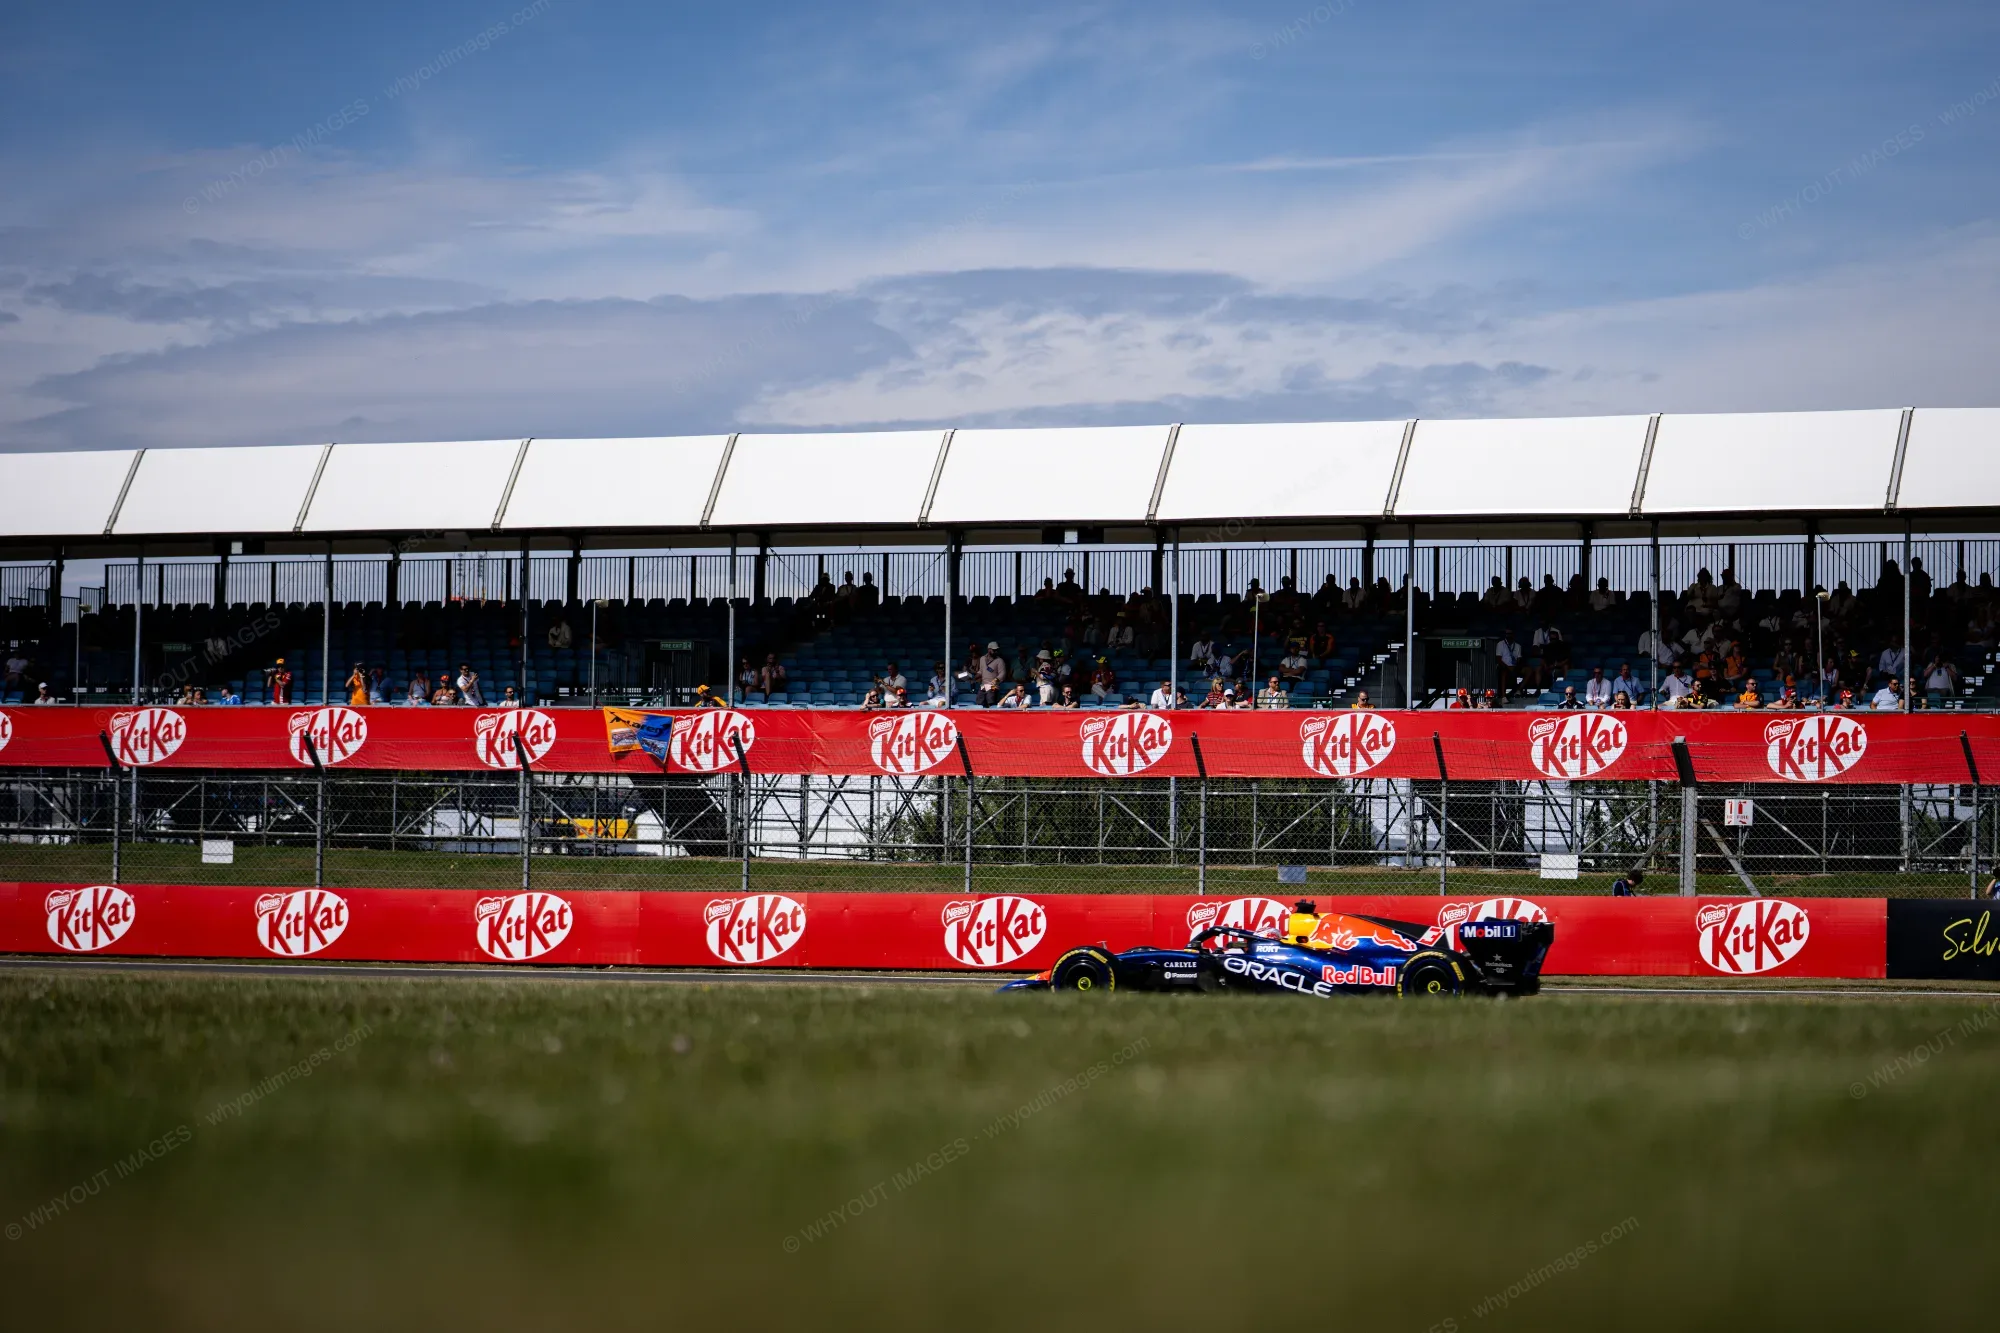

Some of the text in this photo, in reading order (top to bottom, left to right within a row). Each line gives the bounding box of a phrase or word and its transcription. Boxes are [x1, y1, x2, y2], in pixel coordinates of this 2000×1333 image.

[120, 709, 183, 763] KitKat
[299, 709, 363, 765] KitKat
[485, 711, 552, 767] KitKat
[681, 711, 751, 770] KitKat
[881, 713, 955, 772] KitKat
[1093, 714, 1167, 774] KitKat
[1313, 714, 1391, 775] KitKat
[1542, 715, 1622, 777] KitKat
[1779, 717, 1861, 780] KitKat
[57, 888, 130, 949] KitKat
[268, 891, 345, 954] KitKat
[488, 894, 568, 958] KitKat
[718, 896, 801, 961] KitKat
[956, 899, 1042, 965] KitKat
[1464, 926, 1501, 938] Mobil
[1711, 901, 1805, 971] KitKat
[1943, 910, 2000, 960] Silv
[1224, 957, 1334, 999] ORACLE
